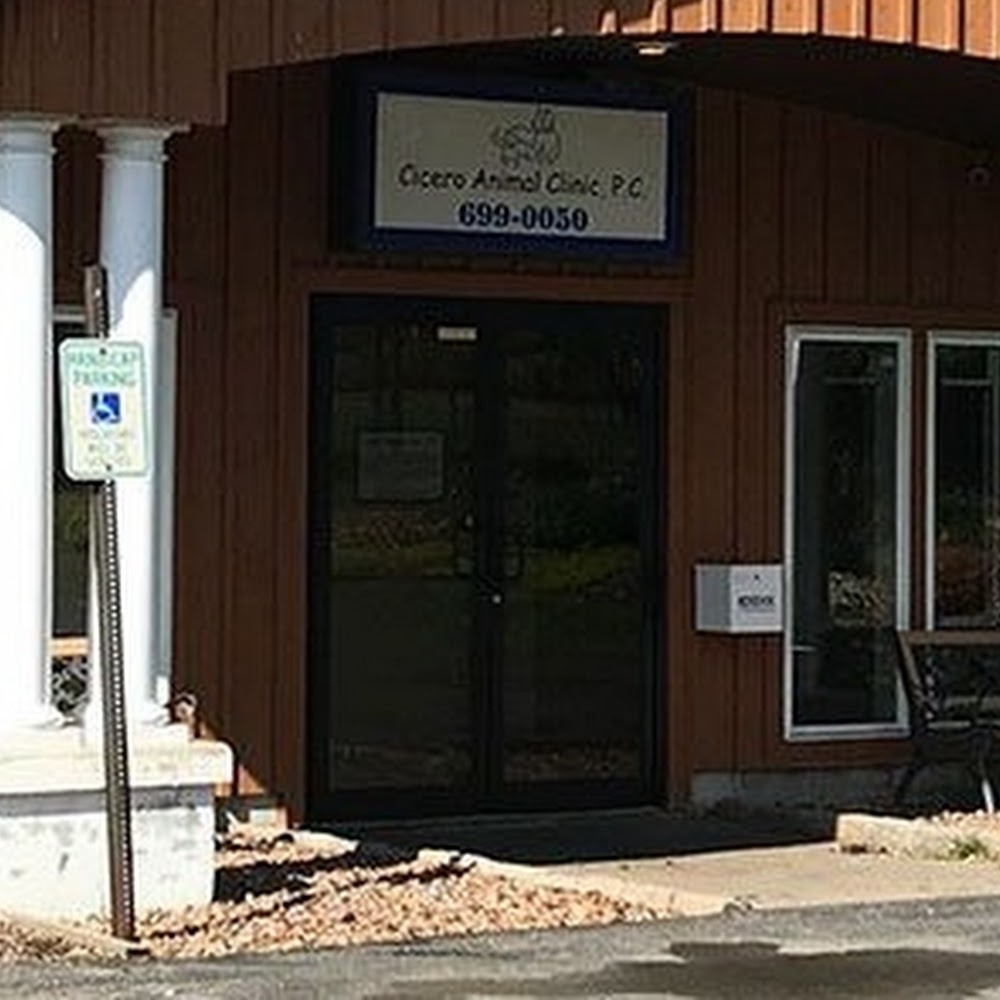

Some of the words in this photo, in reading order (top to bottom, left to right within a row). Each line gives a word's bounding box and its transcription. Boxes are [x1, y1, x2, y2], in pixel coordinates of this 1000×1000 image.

[398, 163, 467, 190] Cicero
[471, 168, 541, 194] Animal
[458, 201, 588, 231] 699-0050
